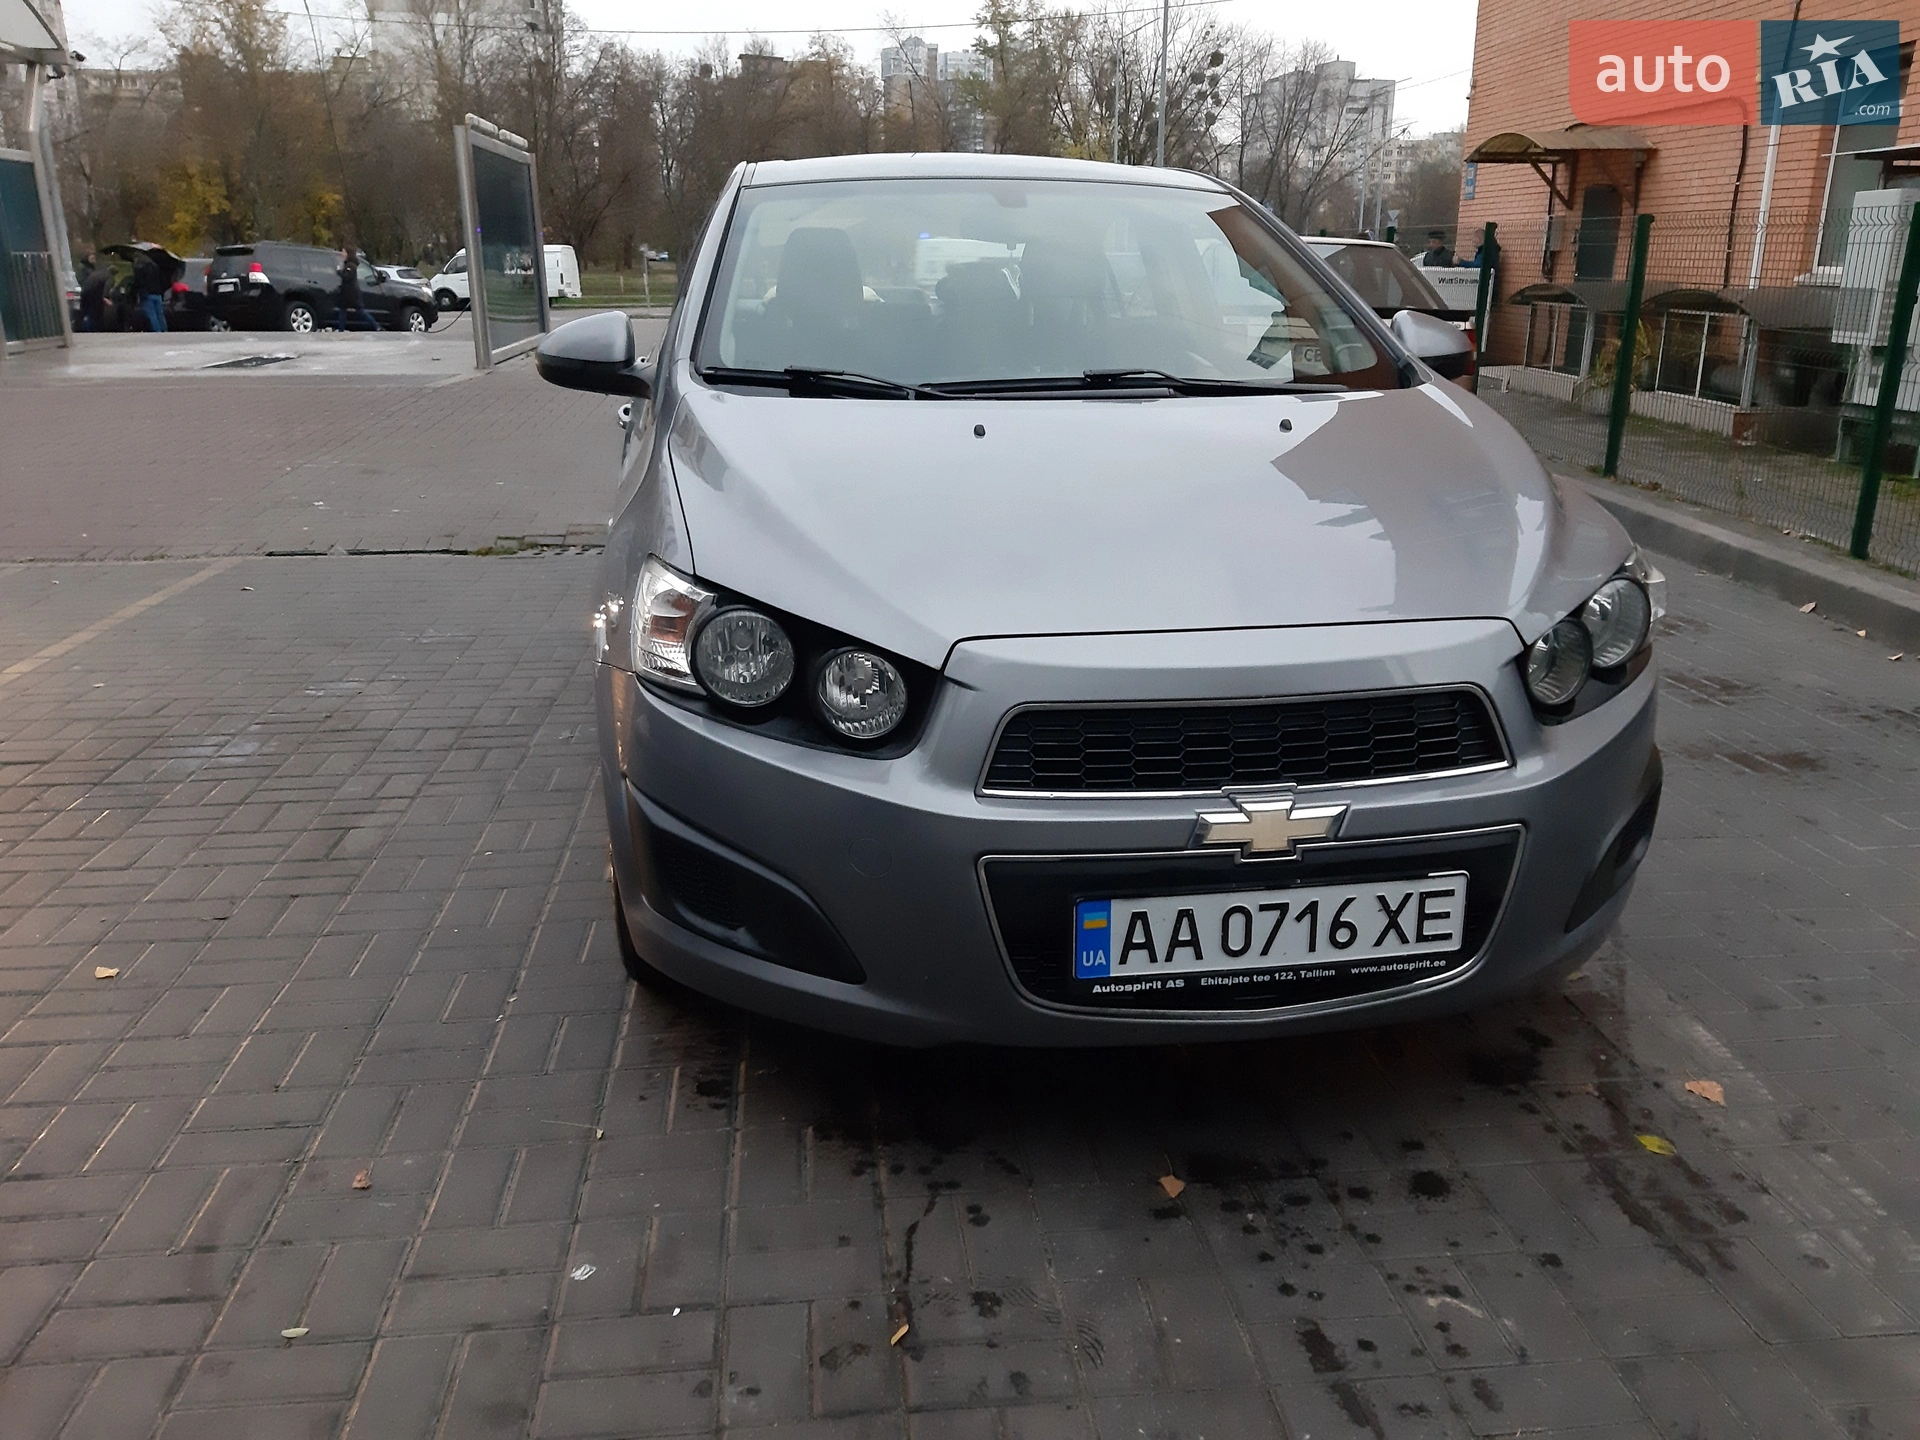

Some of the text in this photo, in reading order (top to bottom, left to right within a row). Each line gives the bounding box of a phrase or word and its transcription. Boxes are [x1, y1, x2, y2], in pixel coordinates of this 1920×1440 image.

[1118, 888, 1456, 966] AA 0716 XE
[1082, 950, 1107, 968] UA
[1092, 959, 1447, 994] Autospirit AS Ehitajate tee 122, Tallinn www.autospirit.ee
